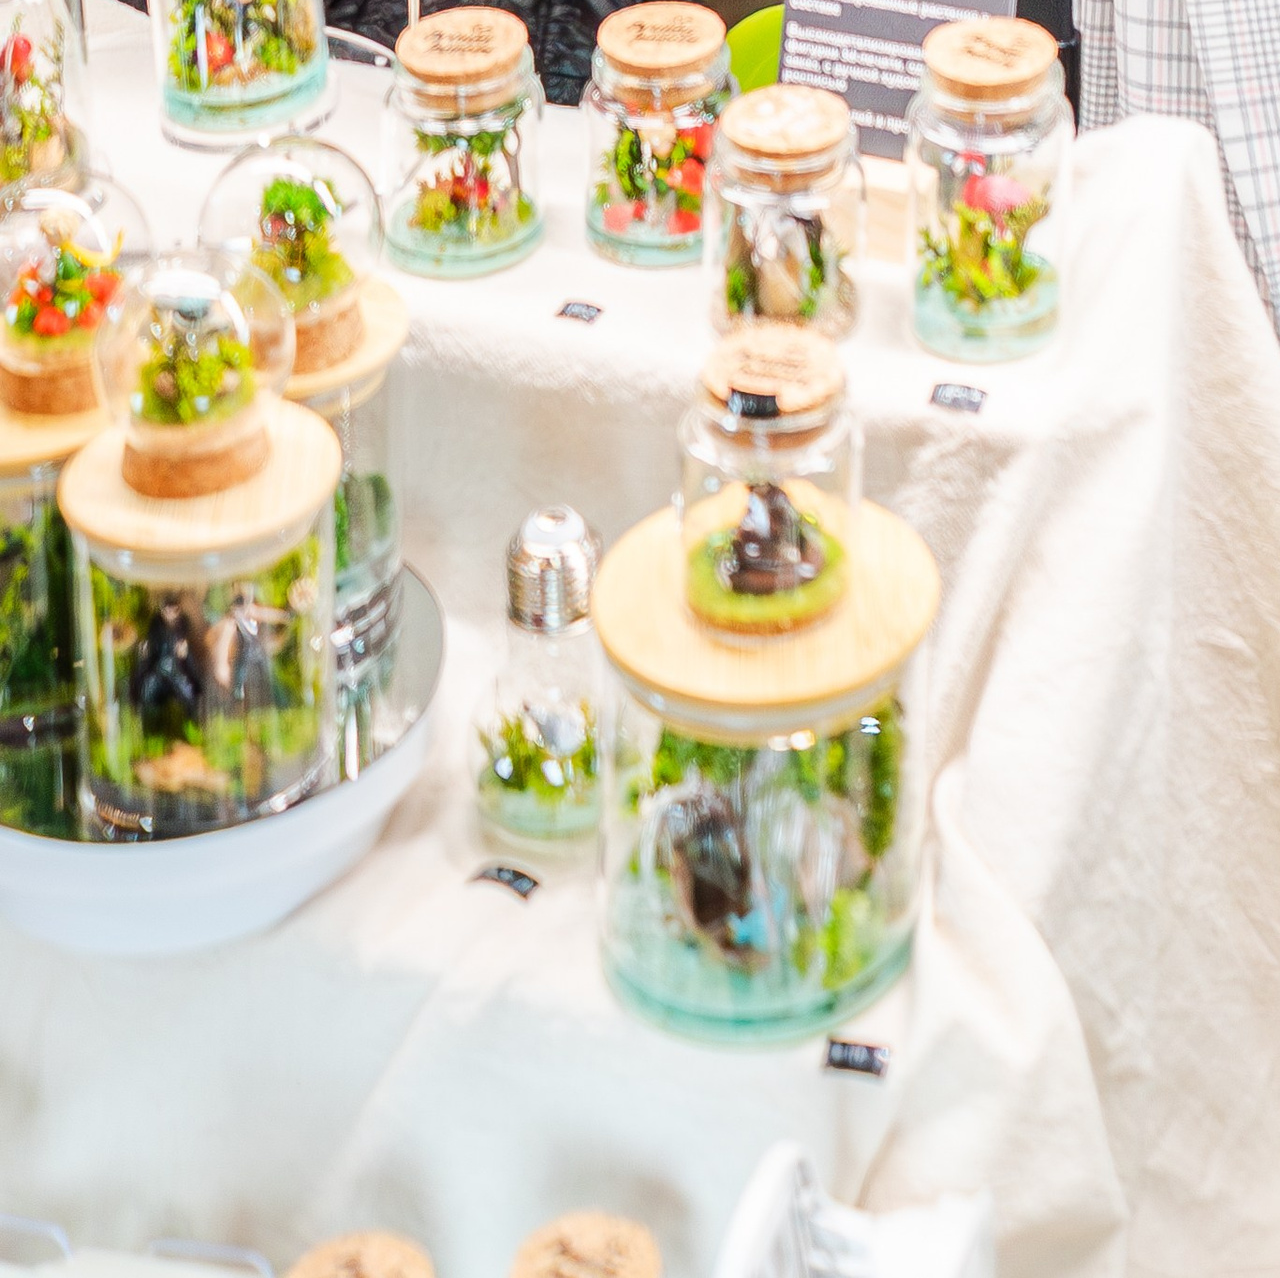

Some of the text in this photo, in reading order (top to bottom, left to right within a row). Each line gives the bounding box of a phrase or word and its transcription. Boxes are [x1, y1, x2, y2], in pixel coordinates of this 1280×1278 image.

[785, 38, 839, 59] фигурки
[784, 71, 846, 92] росписью
[823, 61, 831, 72] с
[833, 64, 880, 82] ручной
